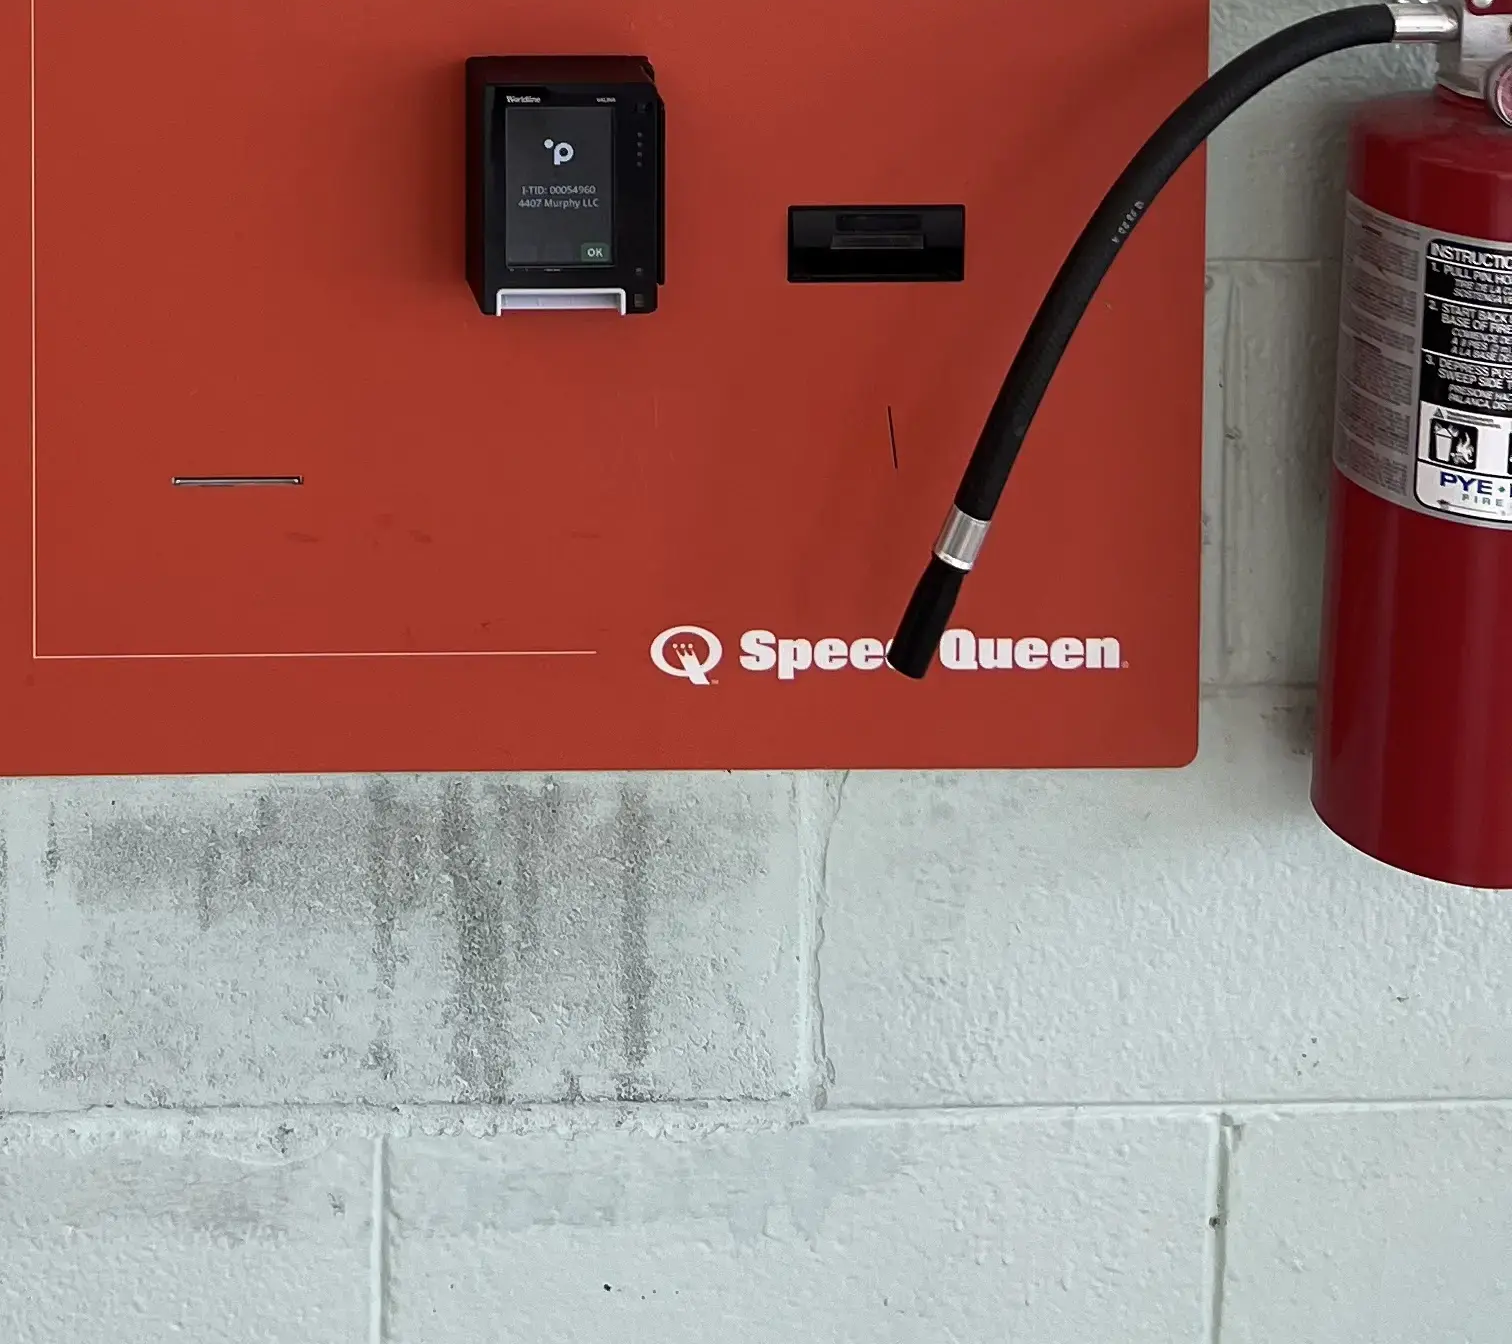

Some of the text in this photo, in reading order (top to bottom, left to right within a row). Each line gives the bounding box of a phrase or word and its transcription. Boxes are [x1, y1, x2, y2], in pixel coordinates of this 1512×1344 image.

[518, 198, 598, 209] 4407 Murphy LLC
[588, 248, 602, 257] OK
[1440, 472, 1492, 494] PYE
[740, 629, 893, 679] Spee
